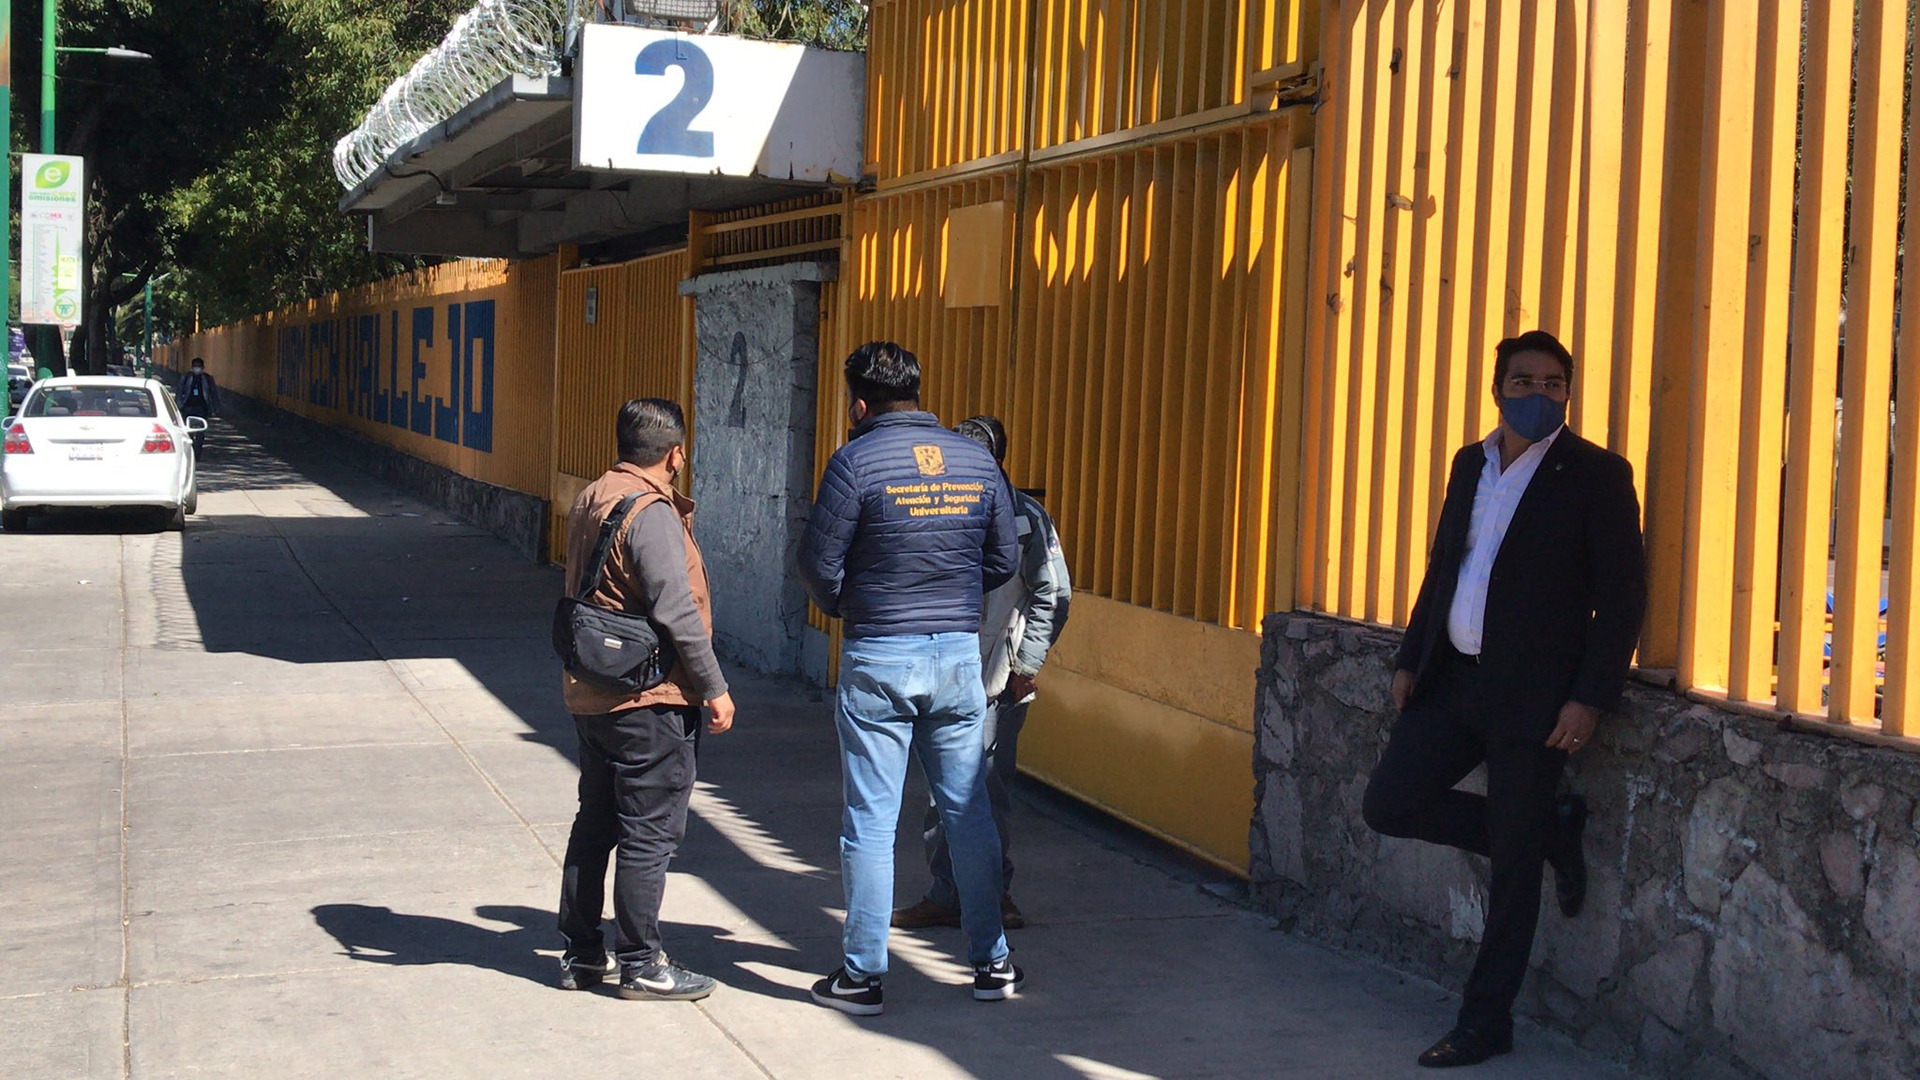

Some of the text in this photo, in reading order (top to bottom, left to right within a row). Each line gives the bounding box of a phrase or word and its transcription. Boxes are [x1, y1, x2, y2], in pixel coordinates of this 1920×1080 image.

[635, 38, 714, 158] 2
[45, 166, 62, 182] e
[29, 195, 76, 203] emisiones
[309, 319, 340, 410] CCH
[345, 299, 496, 454] VALLEJO
[728, 330, 748, 429] 2
[886, 482, 929, 494] Secretaría
[930, 484, 941, 492] de
[895, 494, 980, 506] Atención y Seguridad
[909, 505, 969, 517] Universitaria
